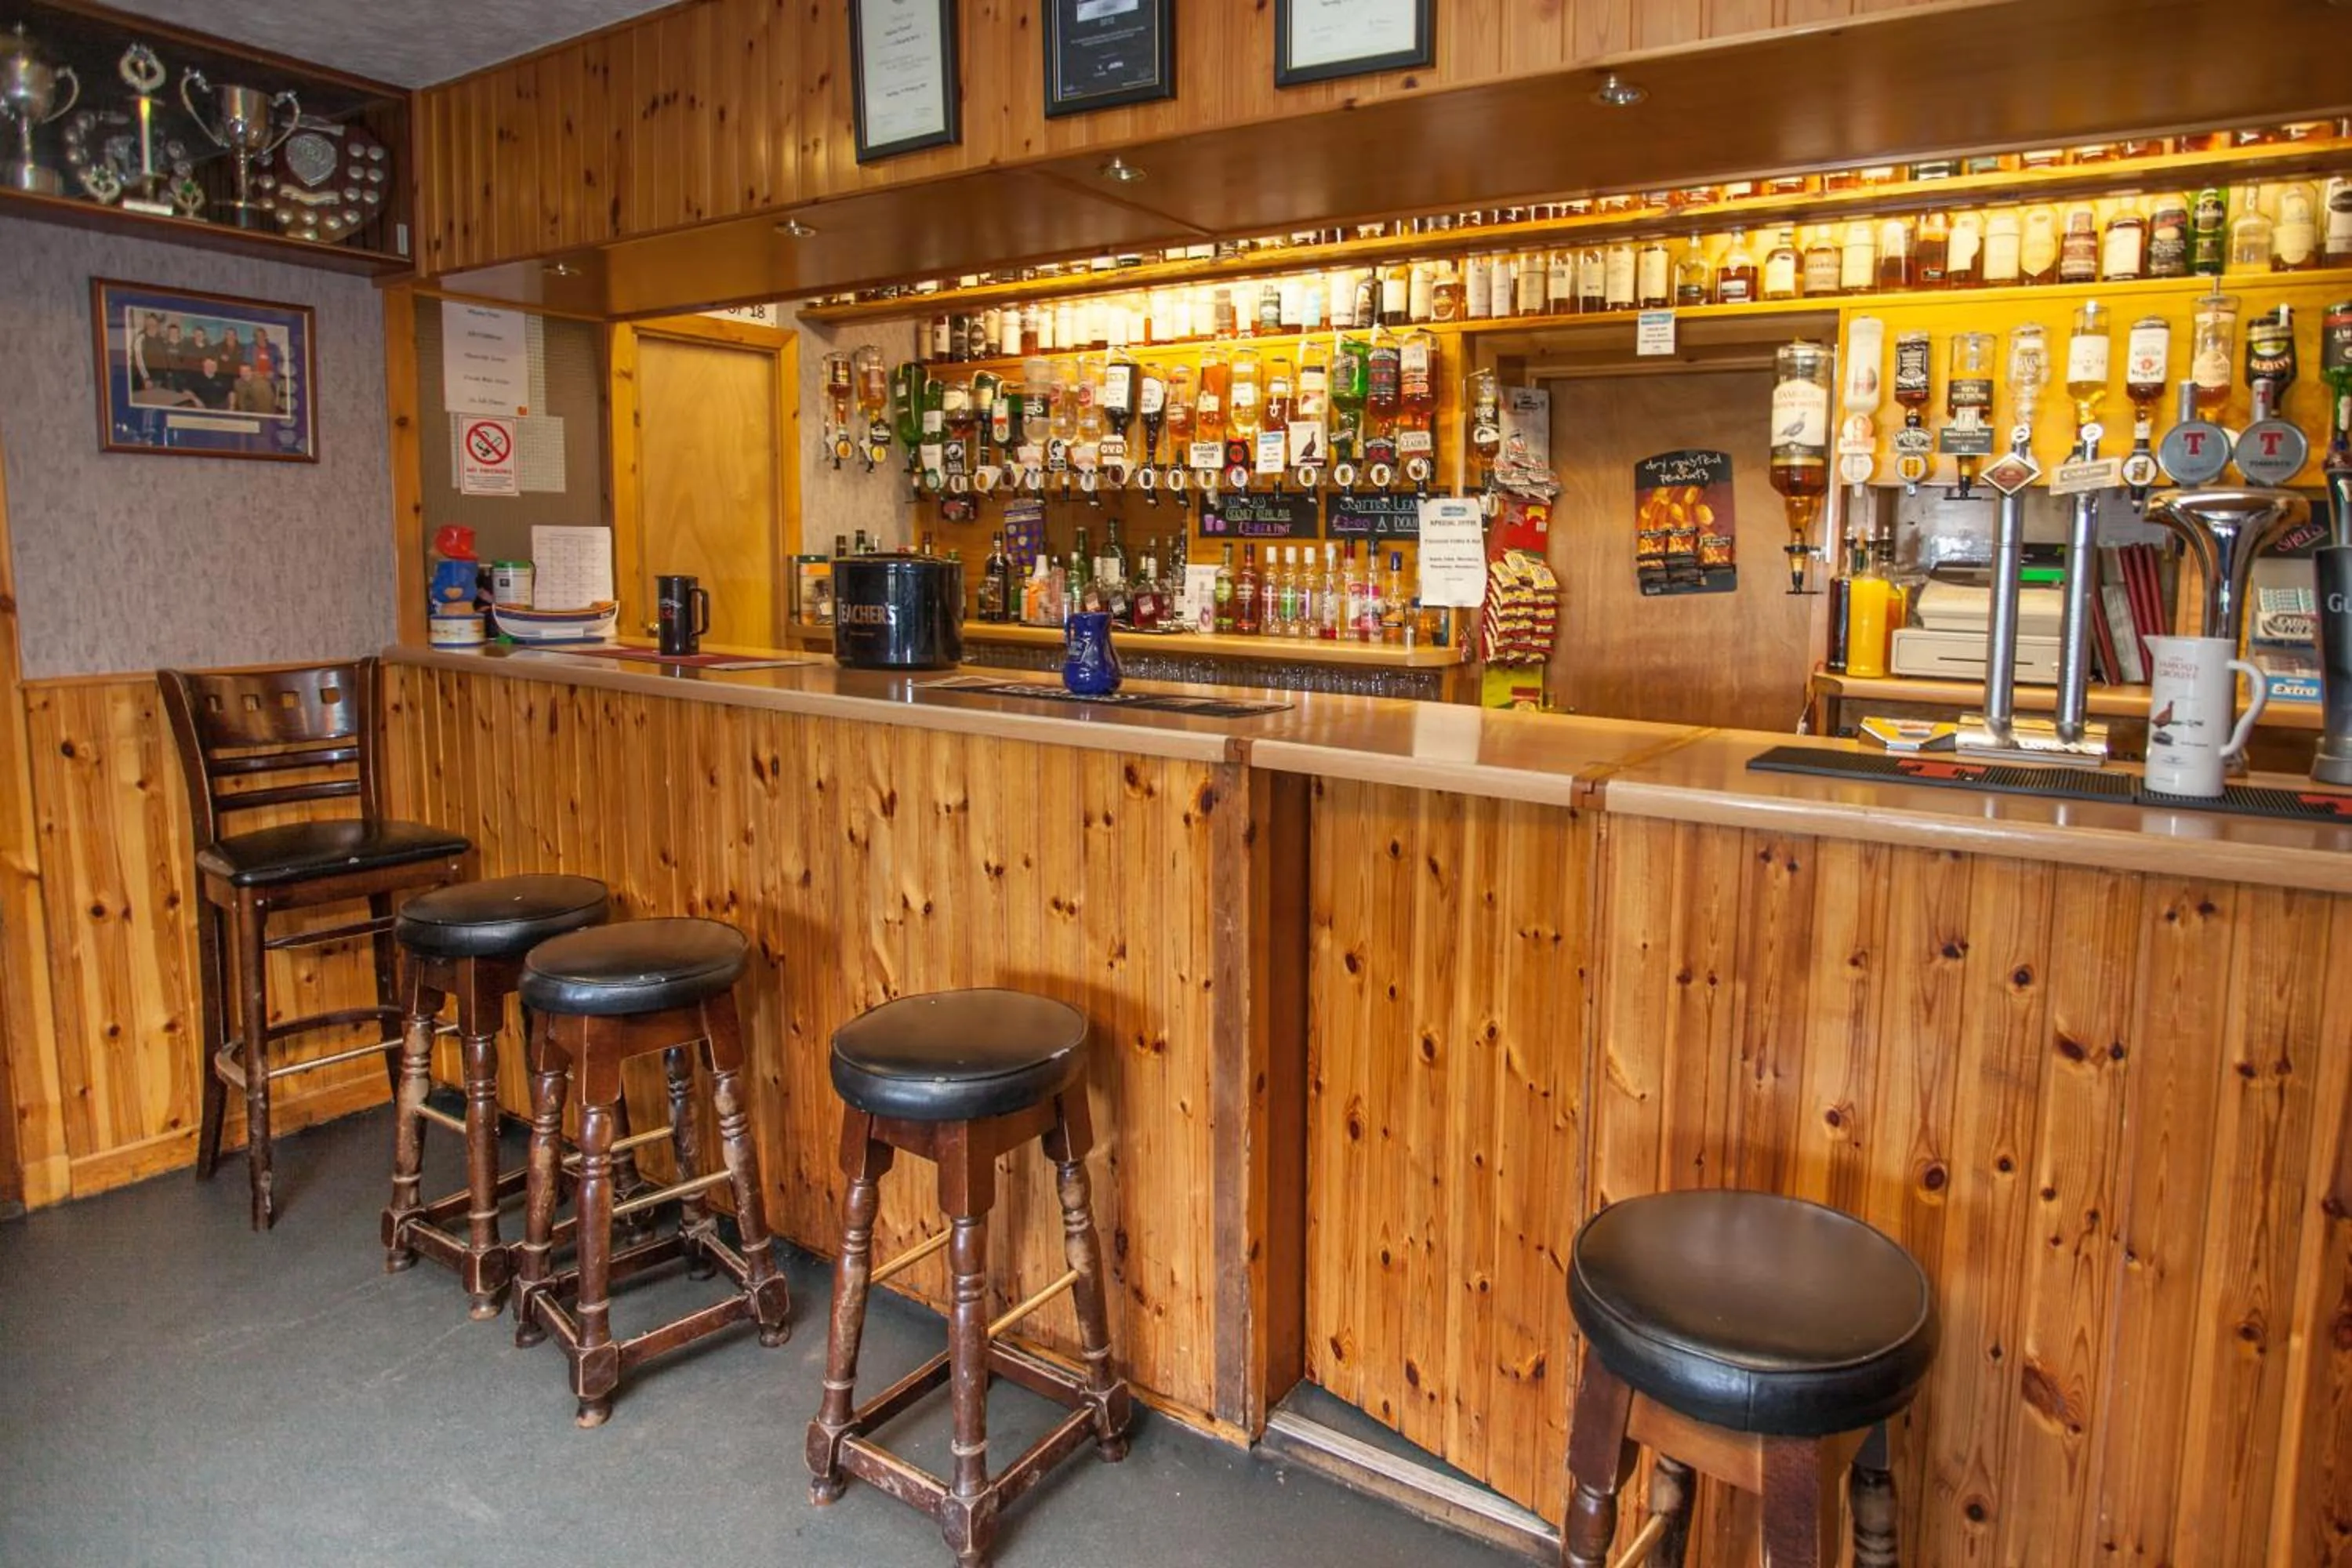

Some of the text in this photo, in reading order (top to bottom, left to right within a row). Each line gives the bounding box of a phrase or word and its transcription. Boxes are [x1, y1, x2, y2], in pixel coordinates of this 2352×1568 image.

[750, 303, 765, 319] 18
[2183, 432, 2206, 456] T
[2259, 432, 2284, 456] T
[1393, 494, 1418, 511] LEA
